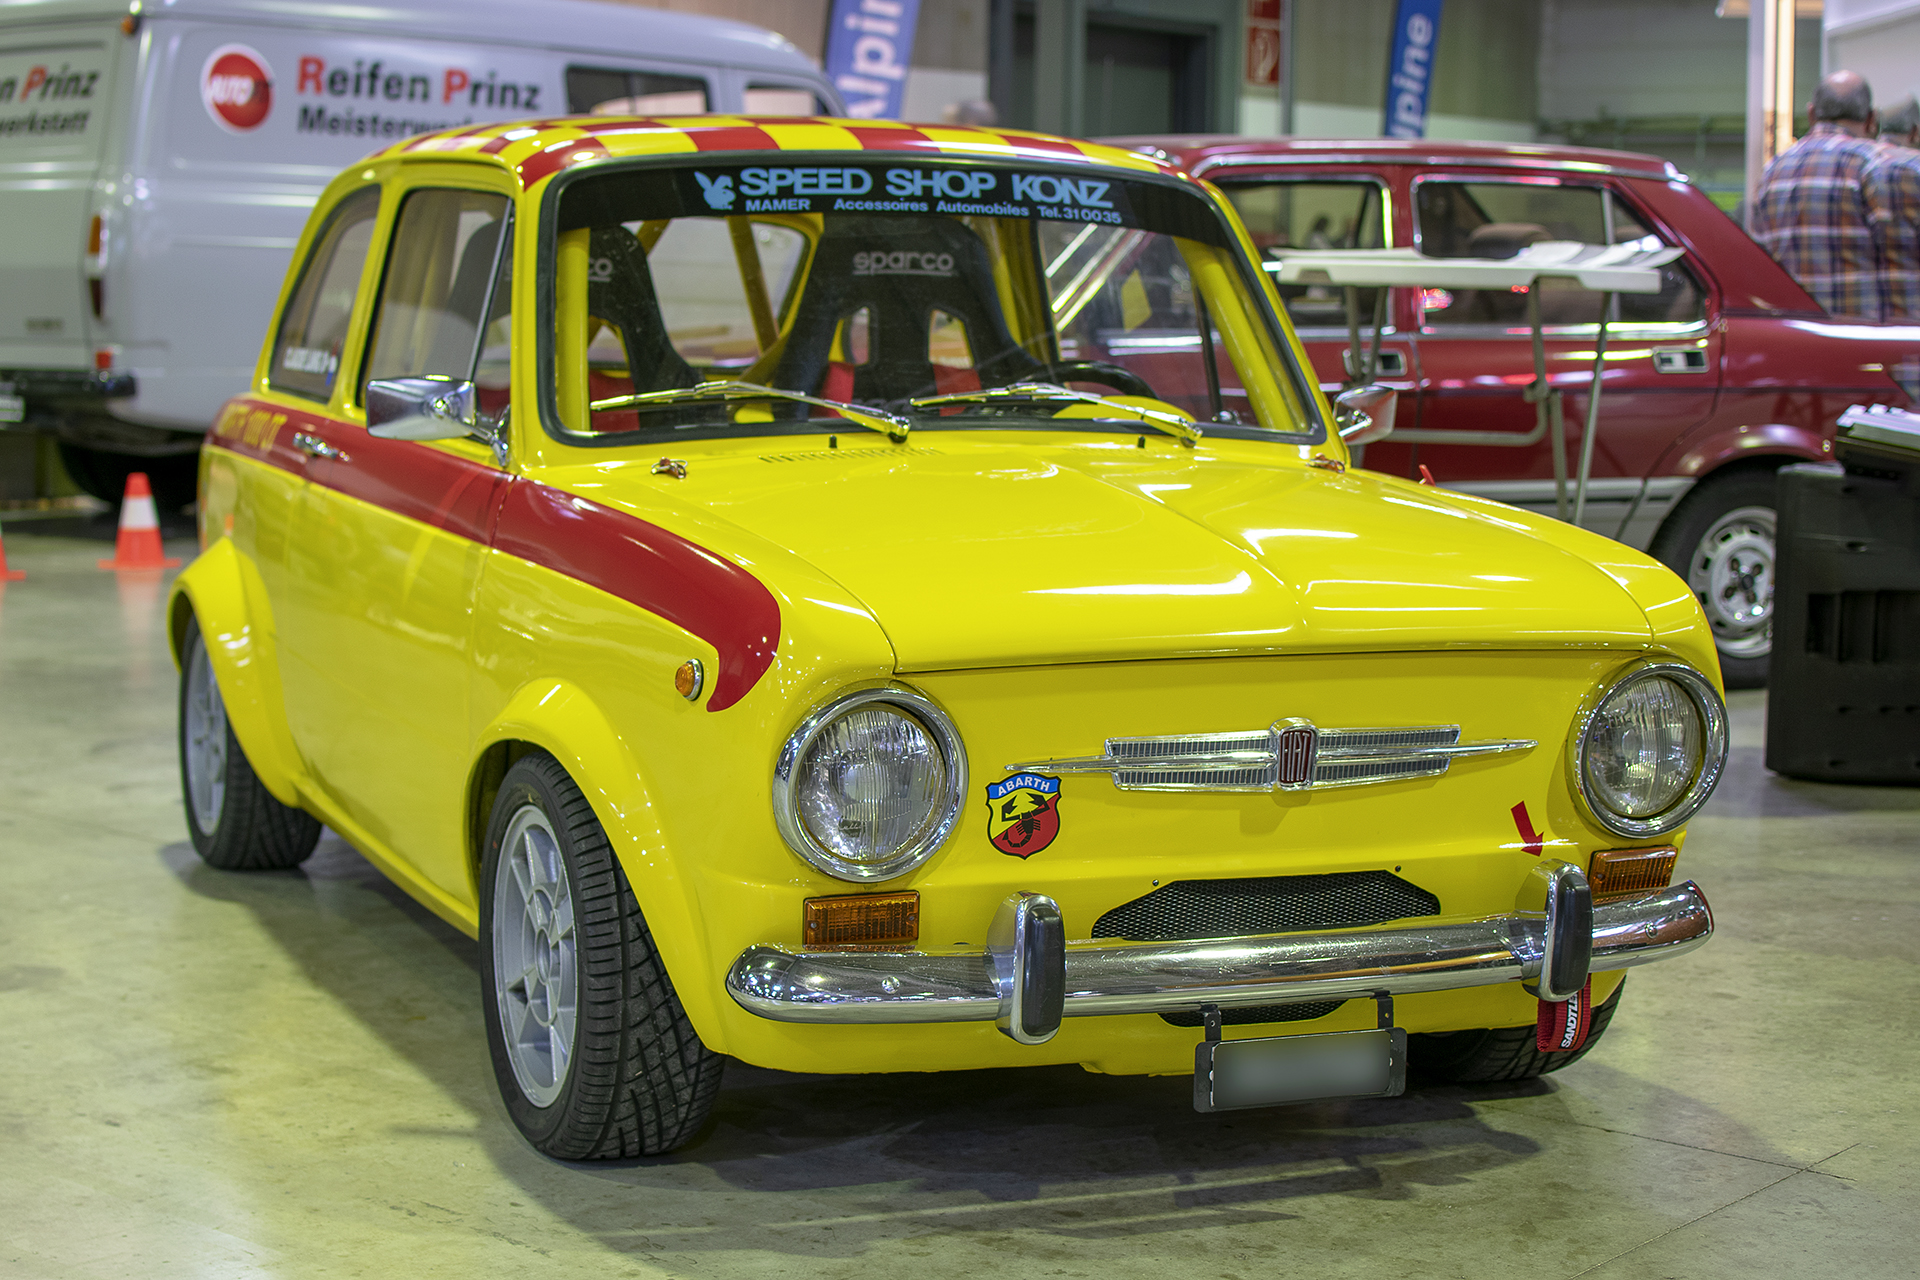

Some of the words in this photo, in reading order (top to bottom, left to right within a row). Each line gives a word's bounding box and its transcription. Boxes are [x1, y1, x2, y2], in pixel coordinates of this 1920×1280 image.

[19, 63, 100, 103] Prinz
[297, 56, 430, 102] Reifen
[442, 68, 541, 110] Prinz
[1390, 12, 1433, 138] lpine
[739, 168, 873, 196] SPEED
[885, 168, 997, 198] SHOP
[1012, 173, 1114, 209] KONZ
[745, 198, 811, 212] MAMER
[833, 198, 929, 212] Accessoires
[936, 200, 1030, 217] Automobiles
[853, 251, 954, 275] sparco
[1281, 731, 1310, 782] FIAT
[998, 776, 1050, 797] ABARTH
[1561, 991, 1578, 1048] SANDTLE
